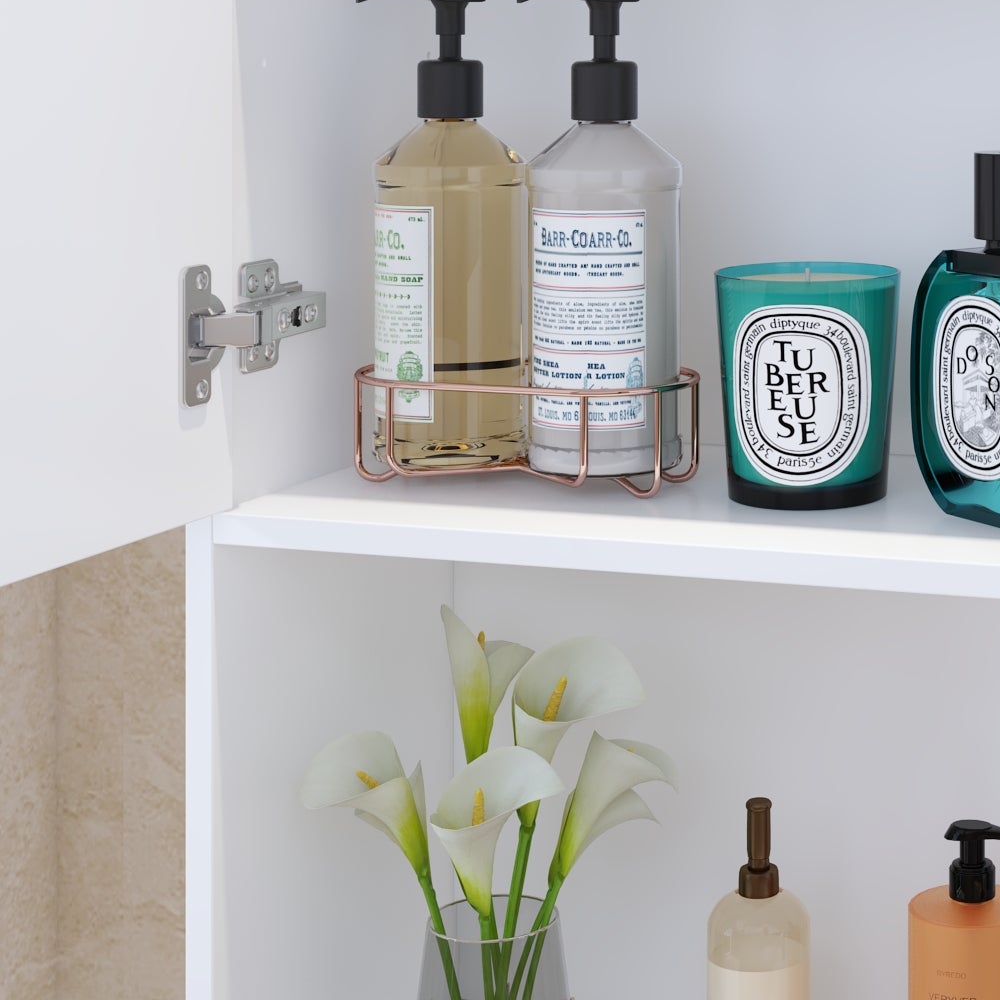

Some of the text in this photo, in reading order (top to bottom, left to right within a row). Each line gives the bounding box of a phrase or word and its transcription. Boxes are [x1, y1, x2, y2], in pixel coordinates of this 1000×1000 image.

[769, 318, 821, 331] diptyque
[962, 309, 993, 326] diptyque
[745, 323, 767, 359] germain
[944, 316, 961, 355] germain
[835, 330, 855, 381] boulevard
[551, 371, 582, 380] LOTION
[595, 372, 626, 380] LOTION
[742, 360, 751, 387] saint
[941, 356, 950, 383] saint
[847, 384, 855, 410] saint
[827, 412, 855, 458] germain
